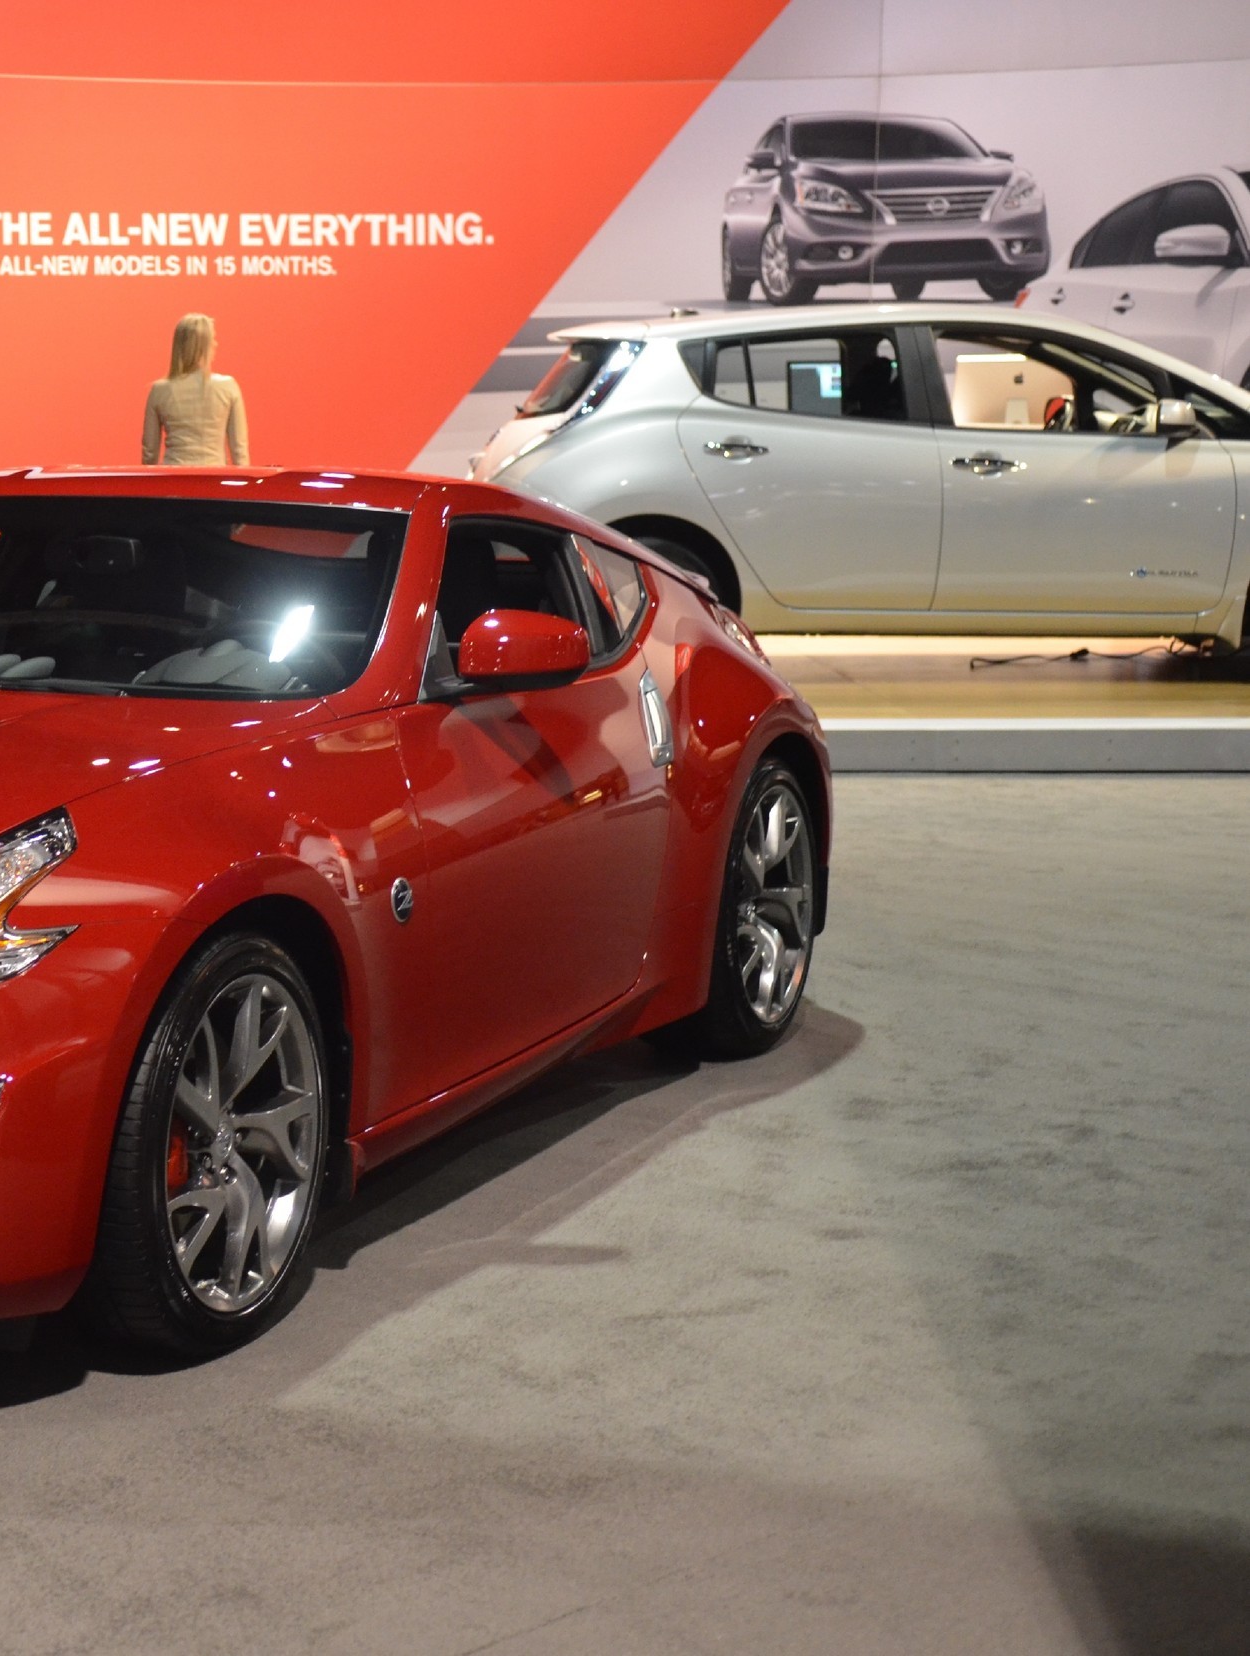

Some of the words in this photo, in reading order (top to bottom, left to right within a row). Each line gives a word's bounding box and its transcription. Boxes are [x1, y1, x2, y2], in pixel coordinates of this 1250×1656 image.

[61, 211, 229, 247] ALL-NEW
[239, 211, 495, 247] EVERYTHING.
[0, 255, 89, 276] ALL-NEW
[93, 255, 181, 276] MODELS
[186, 256, 208, 276] IN
[214, 256, 236, 276] 15
[241, 255, 338, 277] MONTHS.
